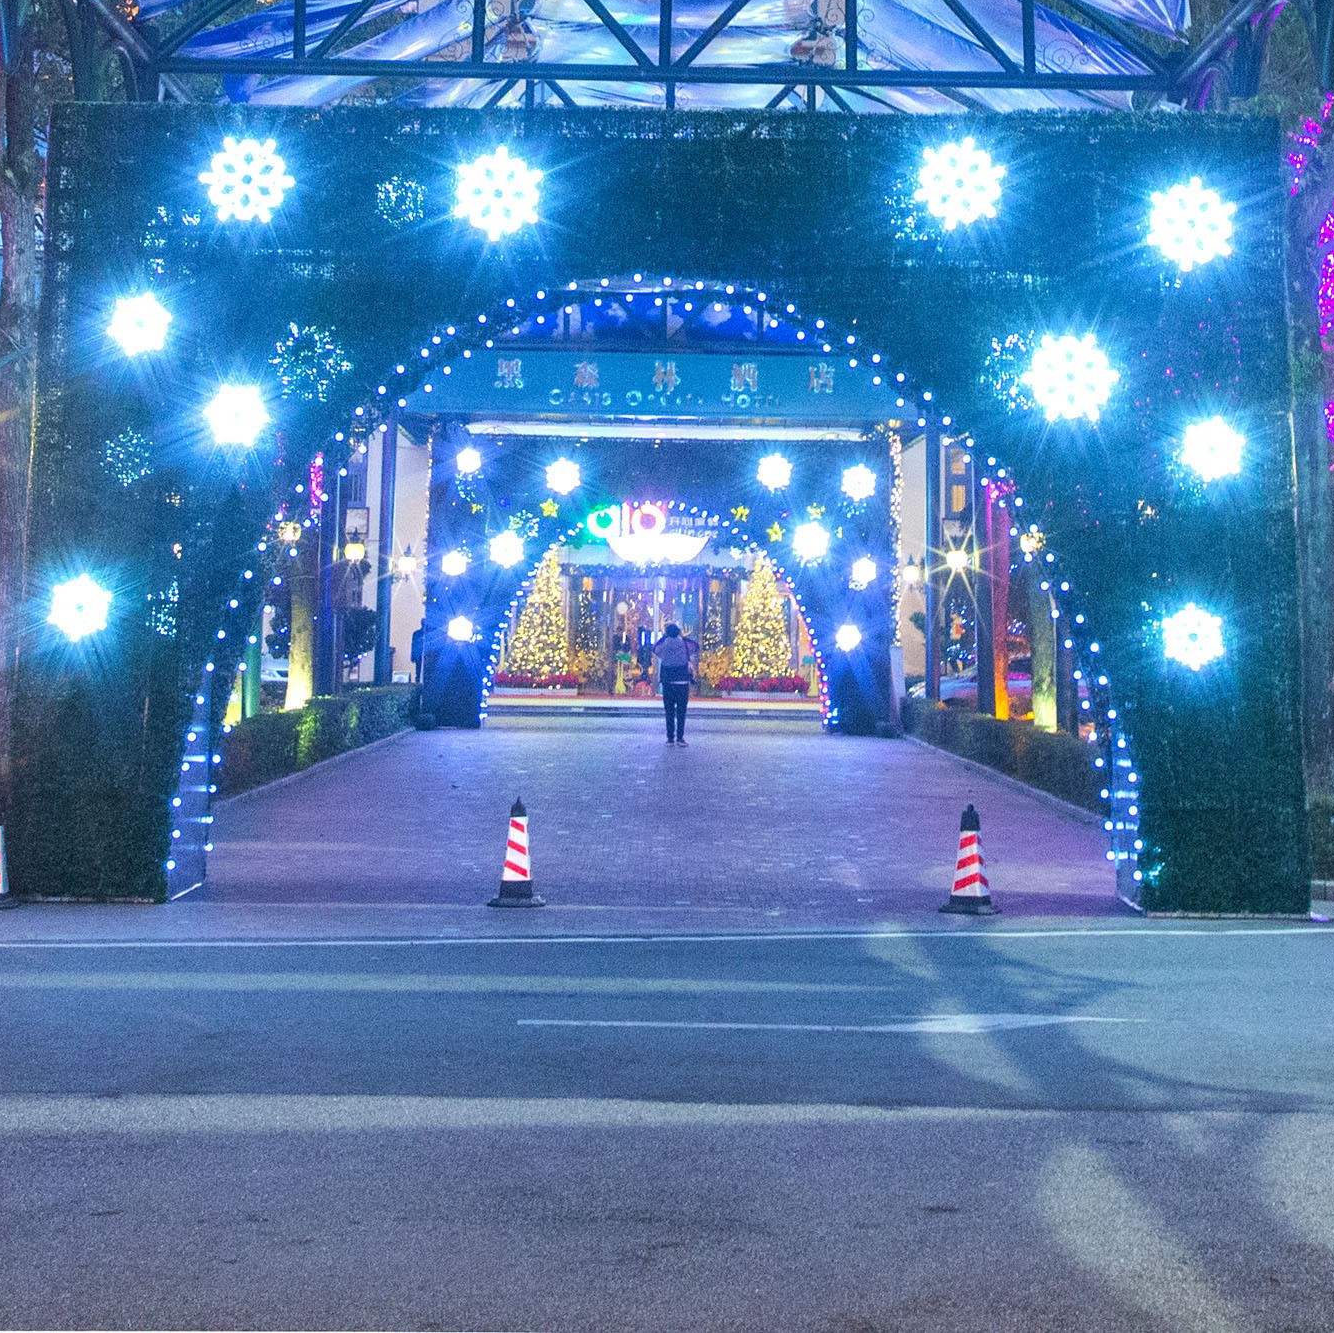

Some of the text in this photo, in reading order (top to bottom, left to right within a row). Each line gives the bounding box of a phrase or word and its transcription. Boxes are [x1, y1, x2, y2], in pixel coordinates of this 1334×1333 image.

[495, 358, 834, 393] 黑森林酒店
